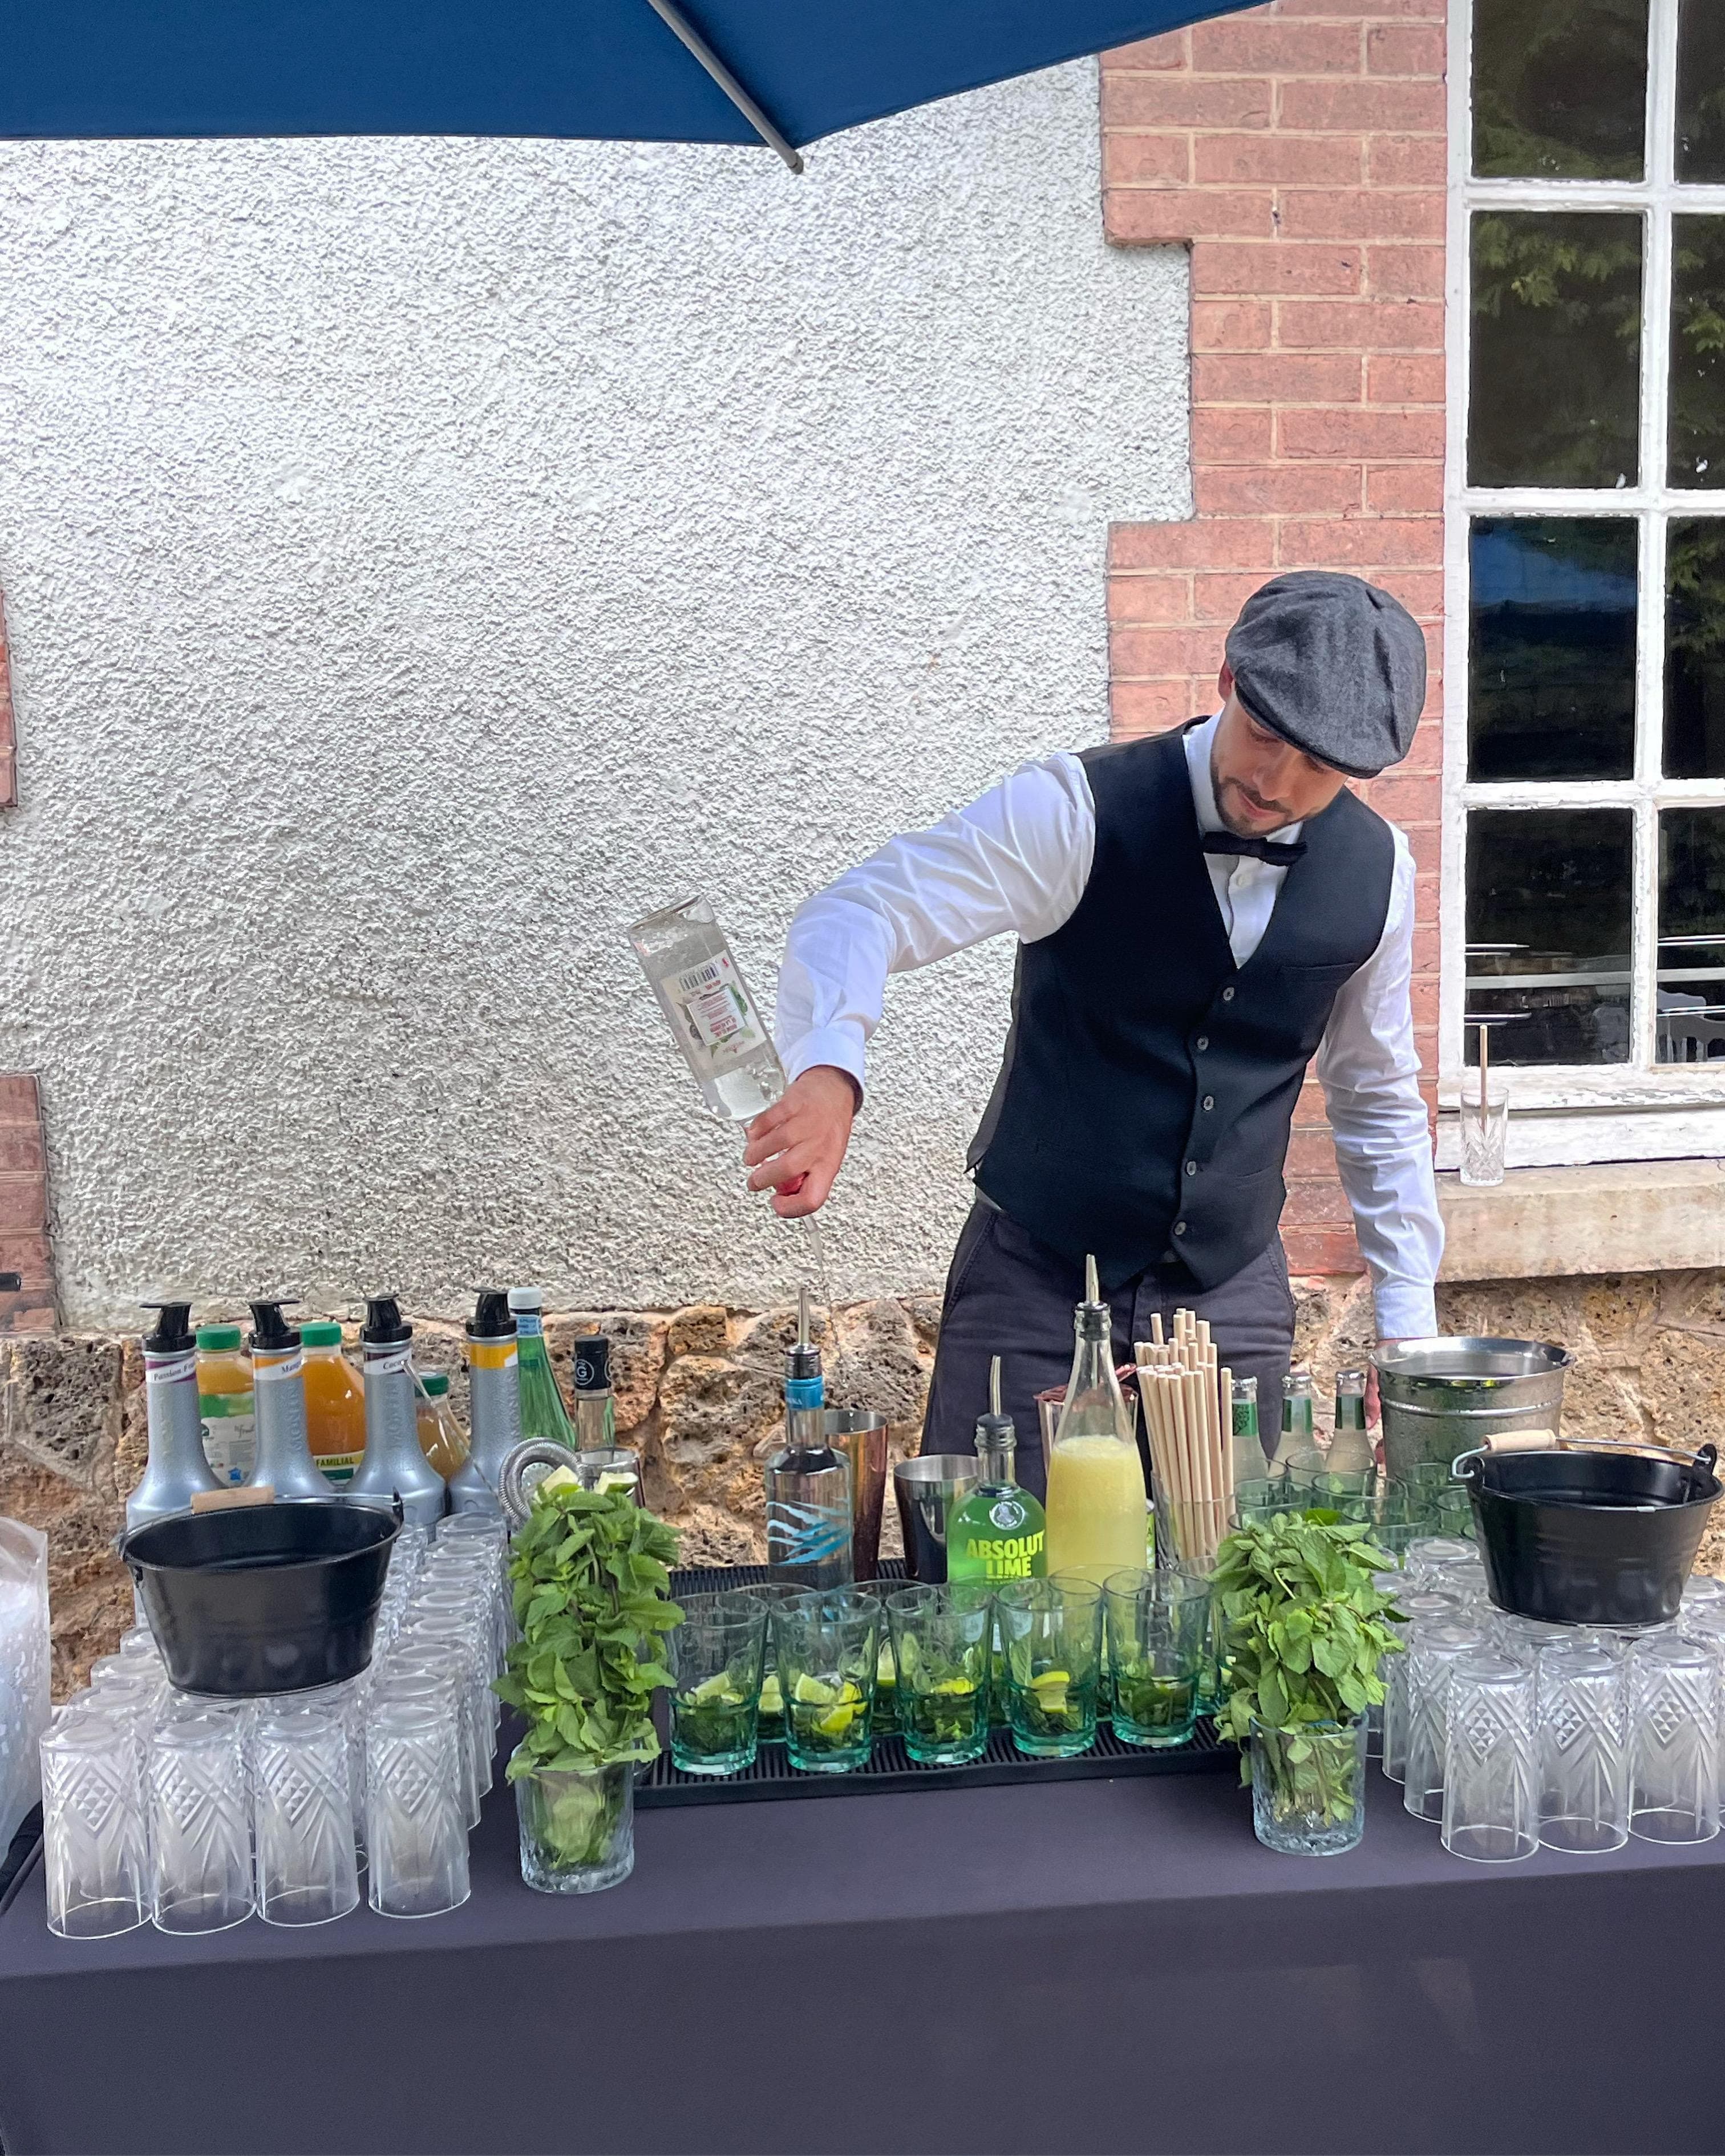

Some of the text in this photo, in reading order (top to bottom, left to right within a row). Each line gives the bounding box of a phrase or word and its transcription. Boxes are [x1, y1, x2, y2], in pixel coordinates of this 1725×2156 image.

[154, 1369, 181, 1381] Passion
[577, 1366, 587, 1377] G
[316, 1457, 355, 1466] FAMILIAL
[967, 1530, 1044, 1559] ABSOLUT
[986, 1556, 1032, 1579] LIME
